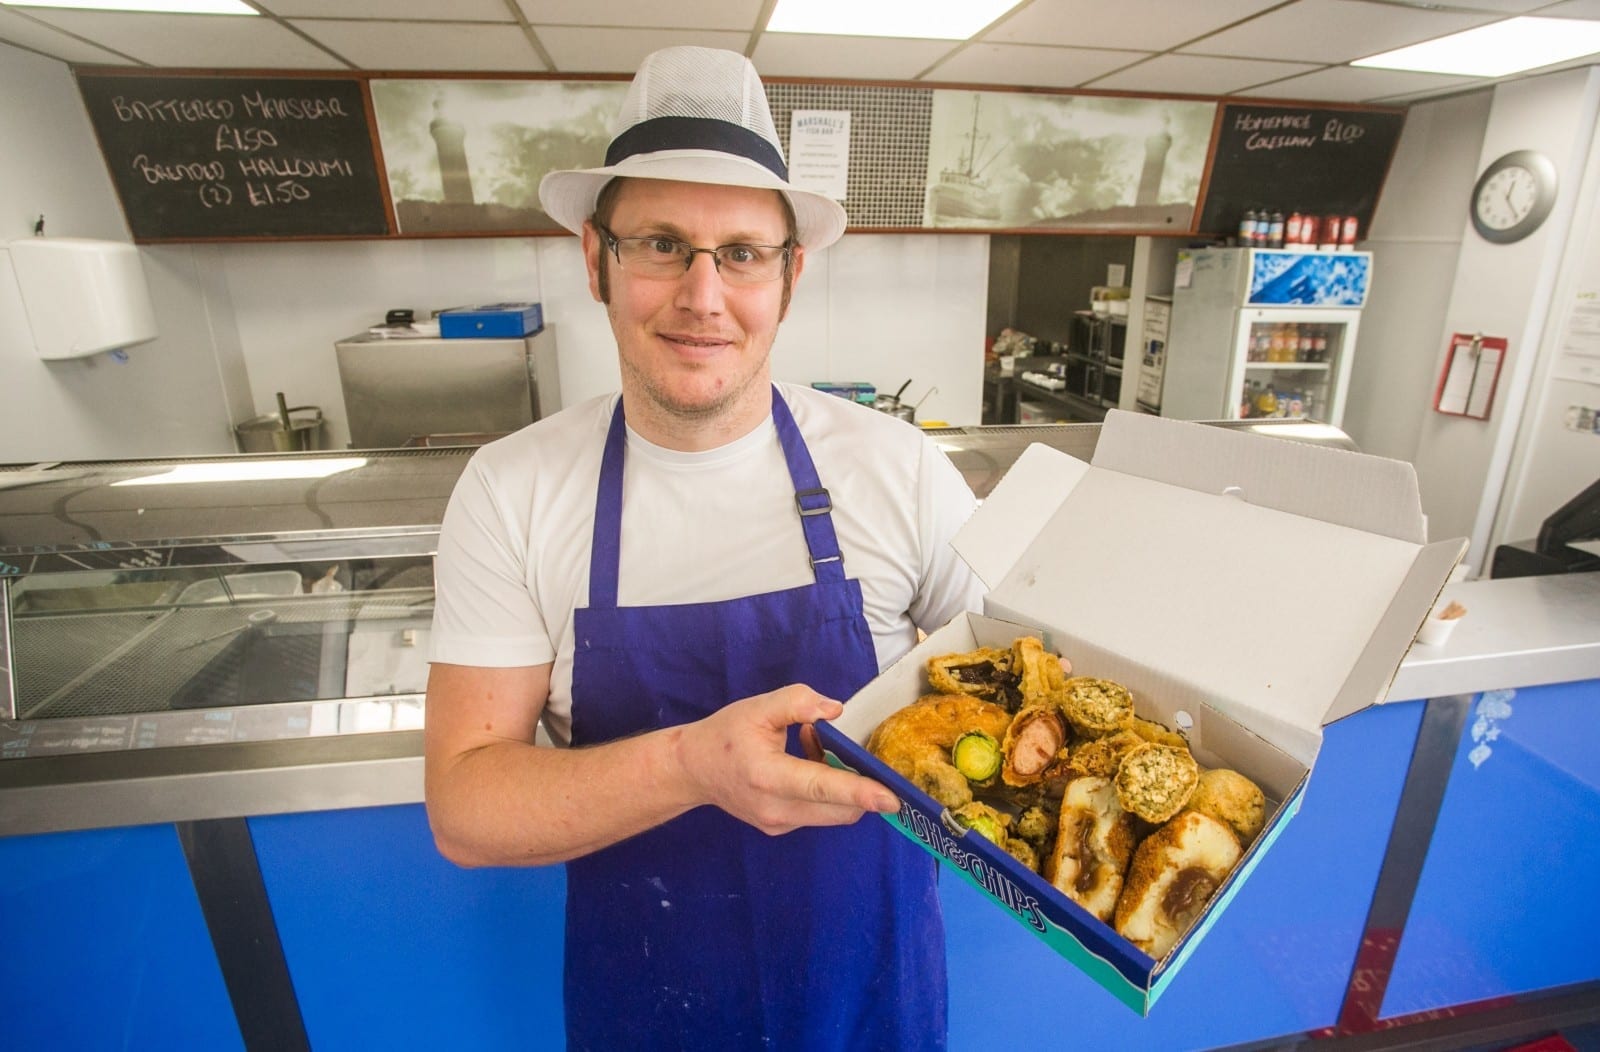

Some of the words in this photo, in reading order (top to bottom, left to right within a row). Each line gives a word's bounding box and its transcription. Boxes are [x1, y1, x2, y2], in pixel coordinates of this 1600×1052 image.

[112, 96, 235, 122] BATTERED
[242, 91, 348, 120] MARSBAR
[1235, 114, 1312, 131] HOMEMADE
[215, 124, 278, 151] £1.50
[1246, 132, 1319, 150] COLESLAW
[239, 158, 353, 177] HALLOUMI
[200, 183, 232, 208] (2)
[246, 180, 310, 206] £1.50
